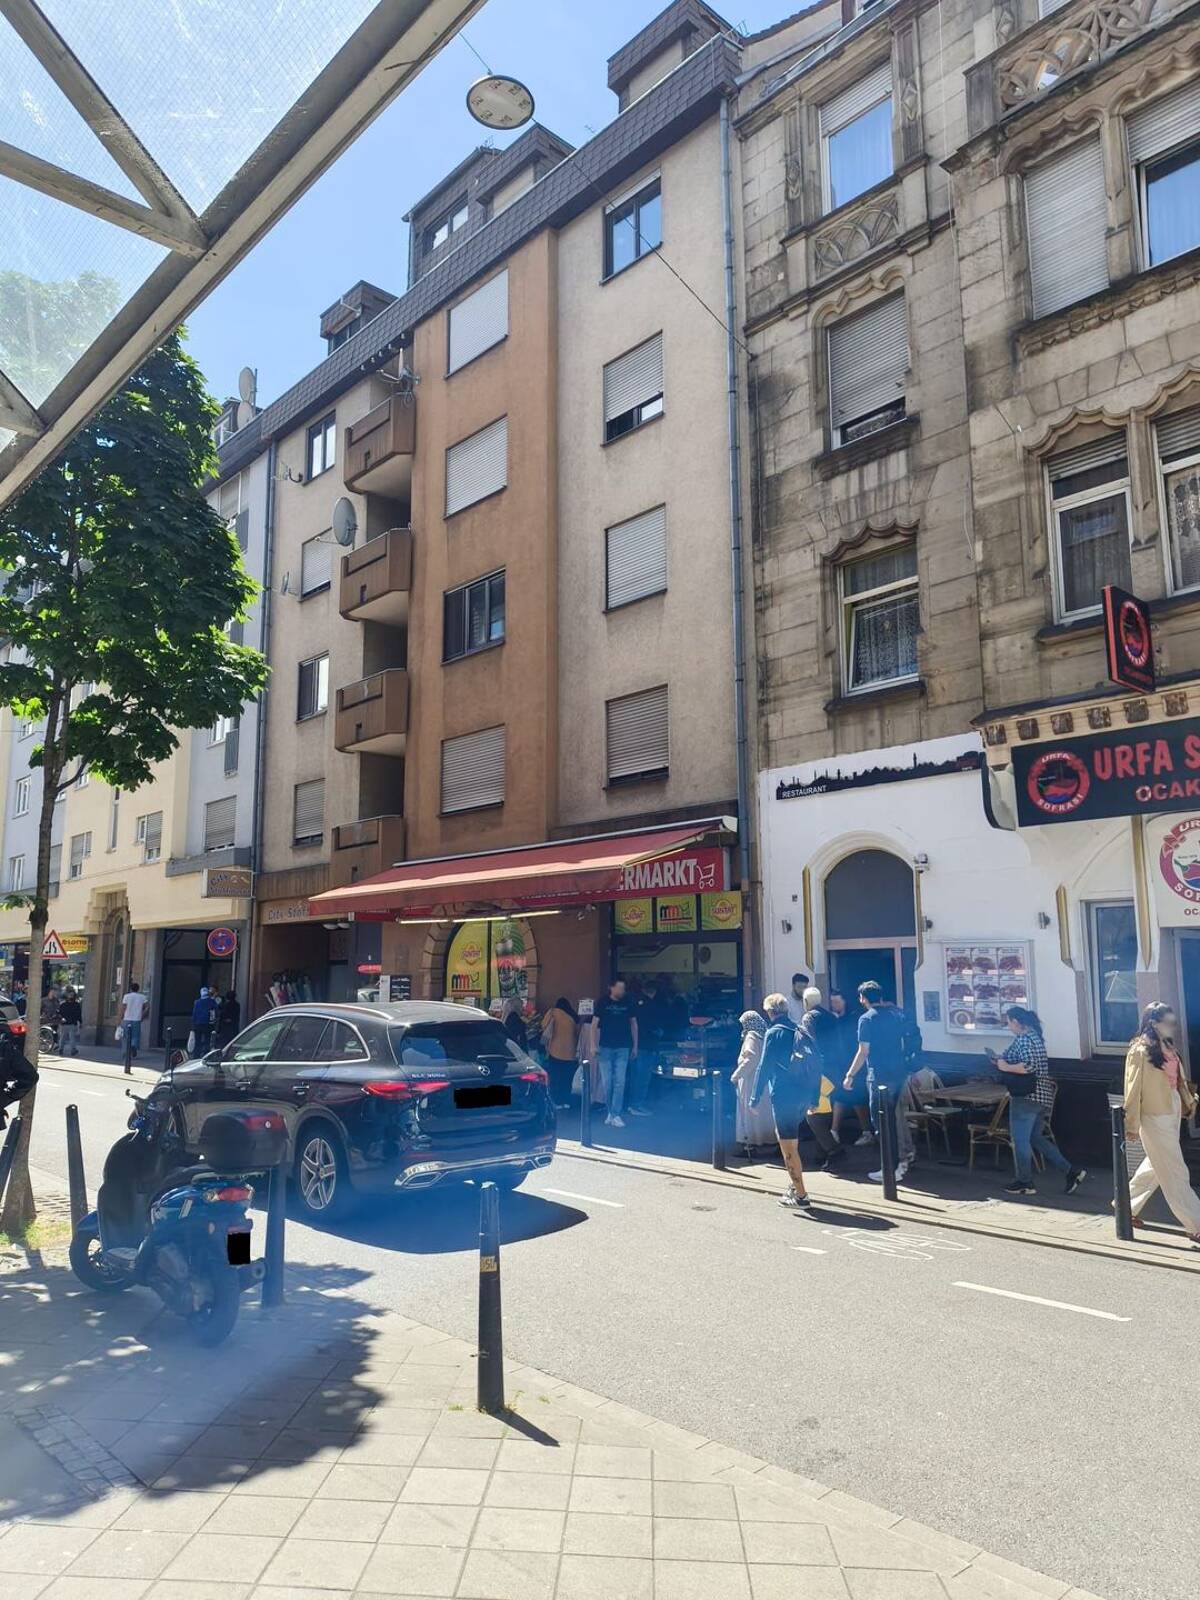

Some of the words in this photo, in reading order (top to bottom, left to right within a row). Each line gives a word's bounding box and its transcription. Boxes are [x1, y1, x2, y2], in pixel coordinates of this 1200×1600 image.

[1041, 752, 1071, 764] URFA
[1094, 739, 1174, 781] URFA
[782, 785, 826, 797] RESTAURANT
[1183, 907, 1200, 916] OC
